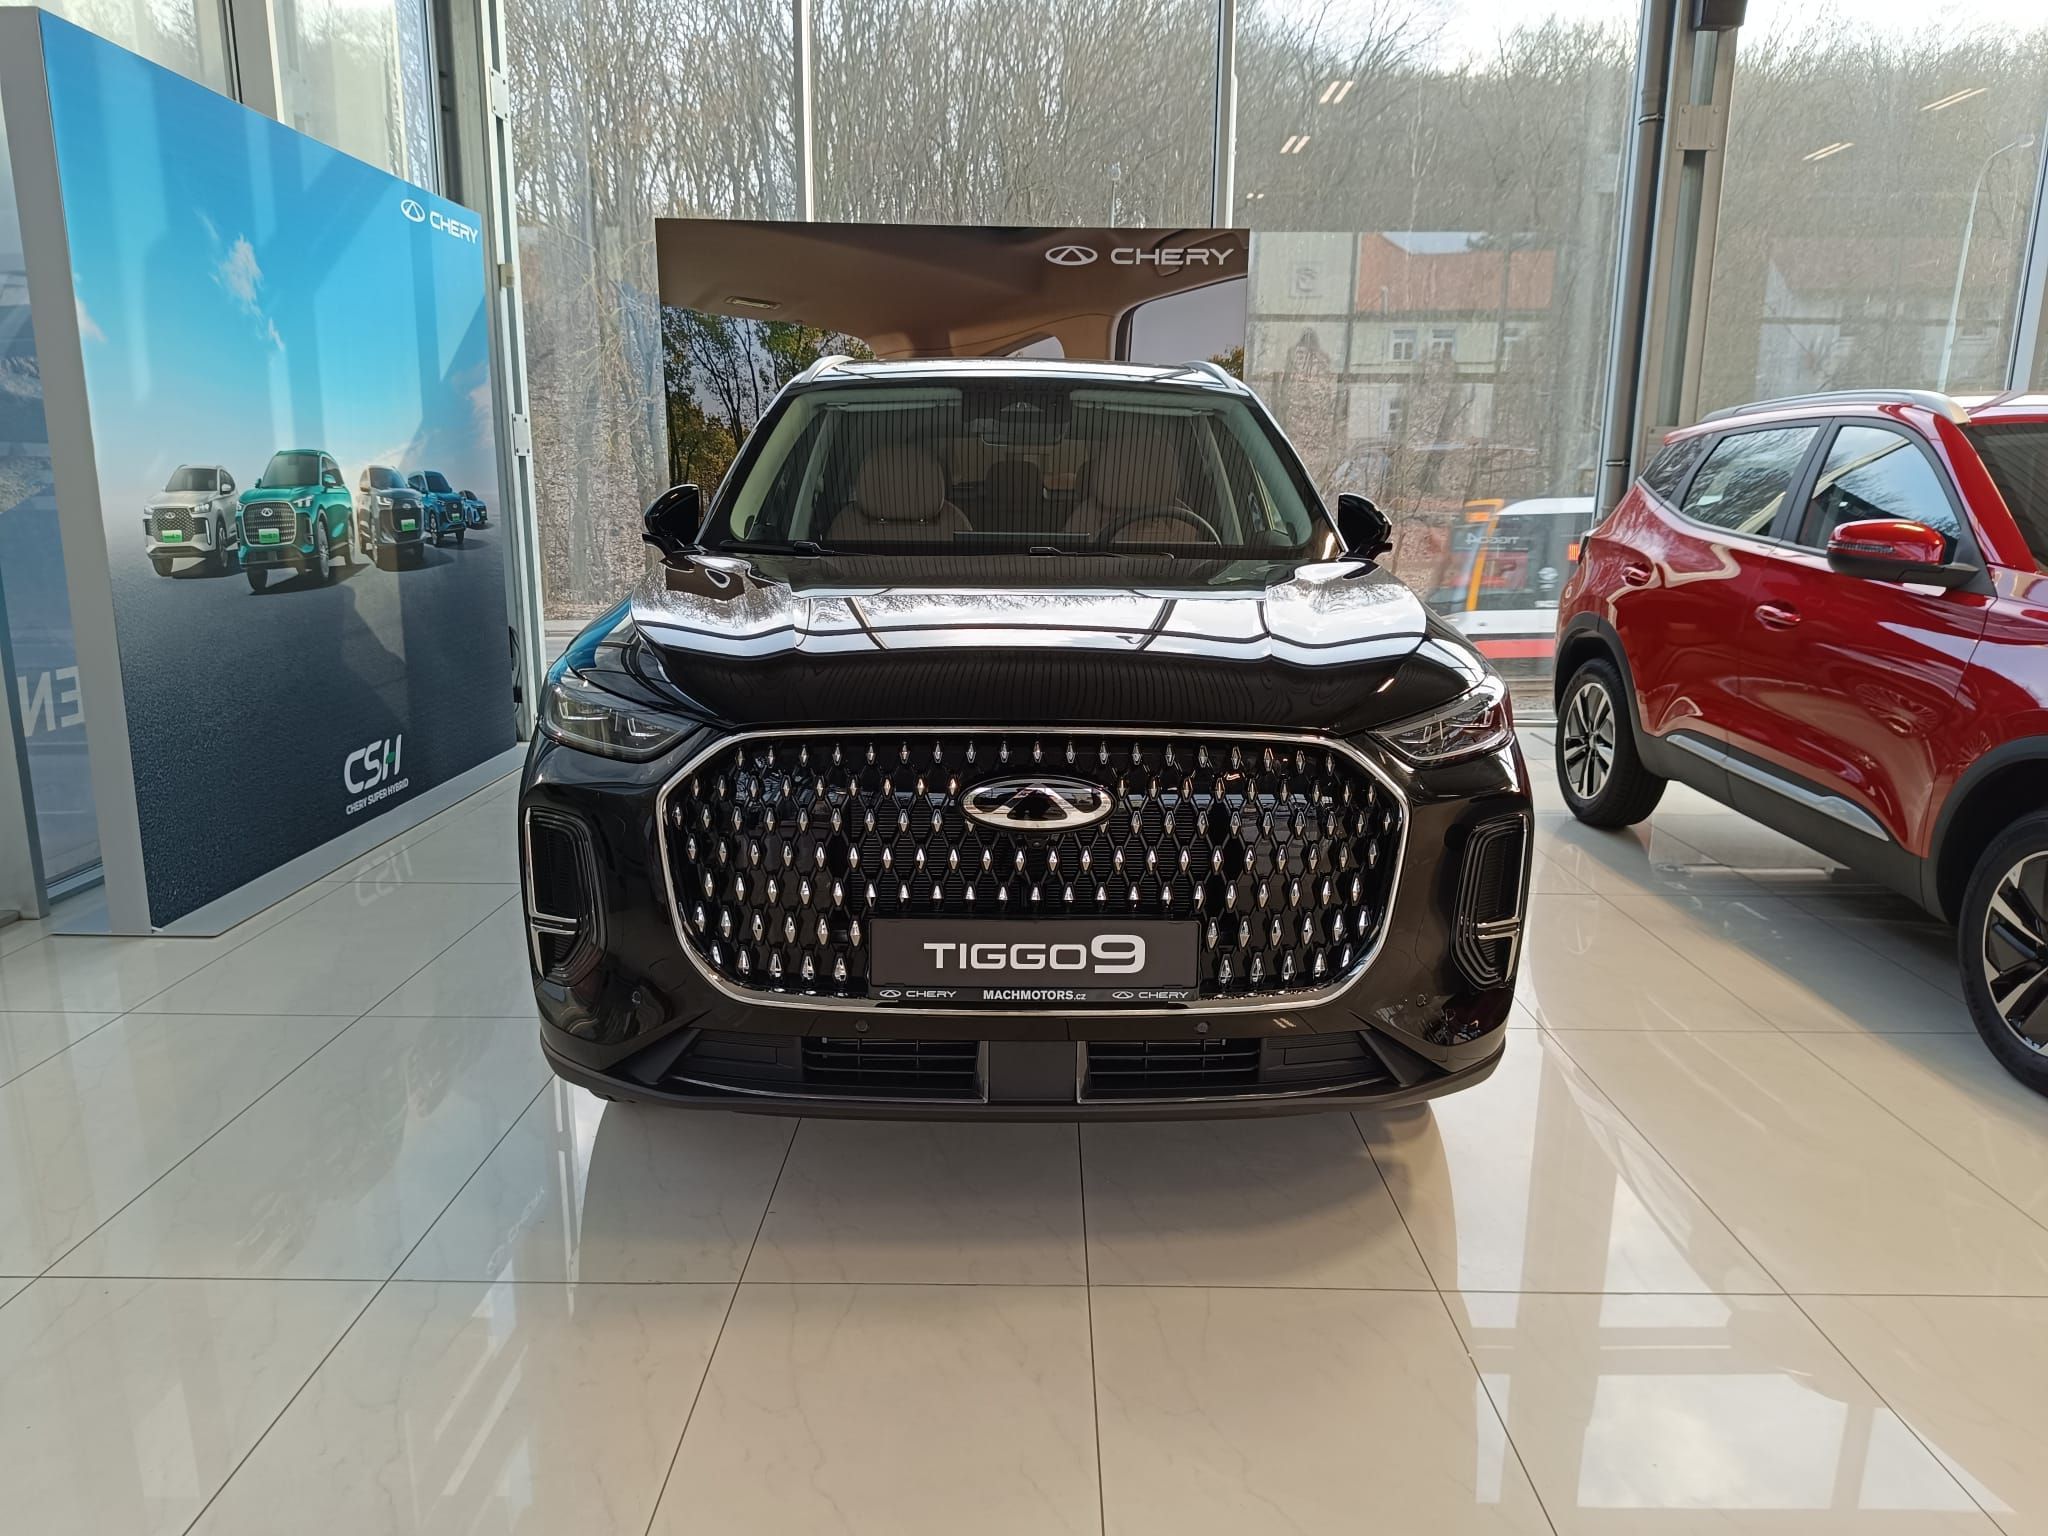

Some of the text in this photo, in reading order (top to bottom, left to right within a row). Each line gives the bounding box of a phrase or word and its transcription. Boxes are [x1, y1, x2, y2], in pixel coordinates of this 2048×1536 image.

[429, 210, 479, 245] CHERY
[1110, 247, 1235, 266] CHERY
[344, 733, 402, 794] CSH
[346, 778, 409, 815] CHERY SUPER HYBRID
[905, 989, 1189, 1001] CHERY MACHMOTORS.cz CHERY
